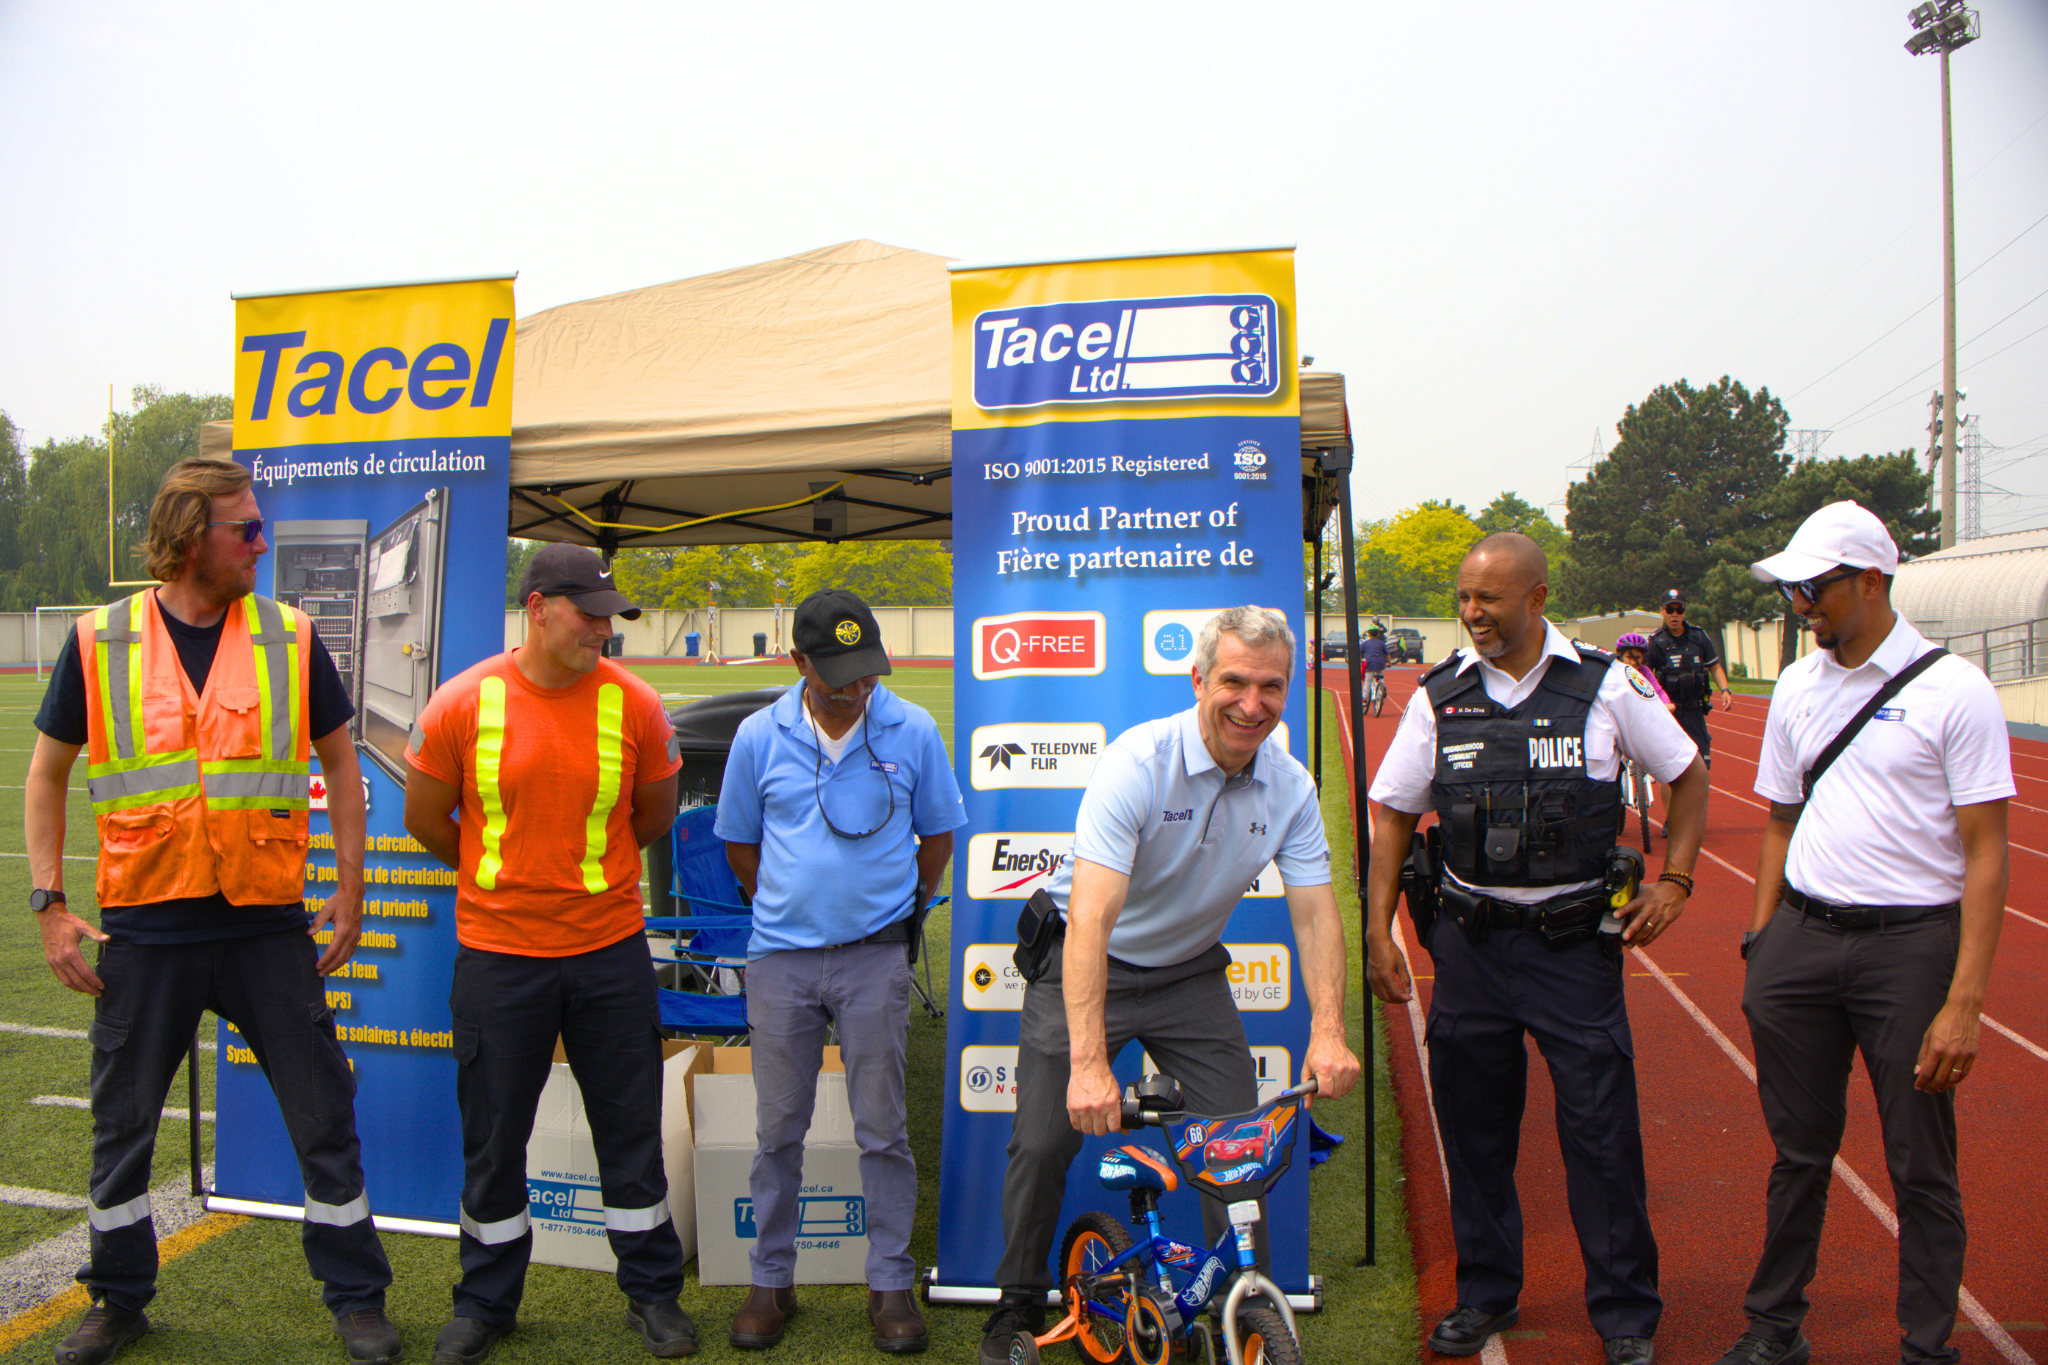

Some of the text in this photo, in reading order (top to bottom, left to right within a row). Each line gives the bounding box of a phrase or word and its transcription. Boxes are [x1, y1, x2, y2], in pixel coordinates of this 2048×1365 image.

[980, 308, 1133, 369] Tacel
[241, 317, 511, 421] Tacel
[1069, 362, 1131, 394] Ltd.
[252, 449, 486, 487] Équipements de circulation
[984, 453, 1210, 481] ISO 9001:2015 Registered
[1233, 453, 1267, 466] ISO
[1234, 472, 1268, 480] 9001:2015
[1011, 502, 1239, 536] Proud Partner of
[997, 541, 1254, 578] Fière partenaire de
[991, 627, 1086, 664] Q-FREE
[1030, 742, 1097, 755] TELEDYNE
[1442, 742, 1485, 755] NEIGHBOURHOOD
[1447, 751, 1478, 763] COMMUNITY
[1528, 736, 1582, 768] POLICE
[1030, 757, 1058, 770] FLIR
[1452, 761, 1474, 770] OFFICER
[1163, 809, 1188, 822] Tacel
[374, 865, 389, 884] de
[390, 866, 459, 886] circulation
[369, 899, 381, 916] et
[382, 899, 428, 918] priorité
[352, 960, 378, 980] feux
[1004, 982, 1018, 990] we
[1245, 987, 1259, 1001] by
[1263, 986, 1281, 1000] GE
[349, 1024, 398, 1045] solaires
[399, 1030, 409, 1046] &
[1189, 1126, 1203, 1144] 68
[541, 1170, 600, 1183] www.tacel.ca
[1224, 1168, 1239, 1181] HOT
[540, 1222, 607, 1238] 1-877-750-4646
